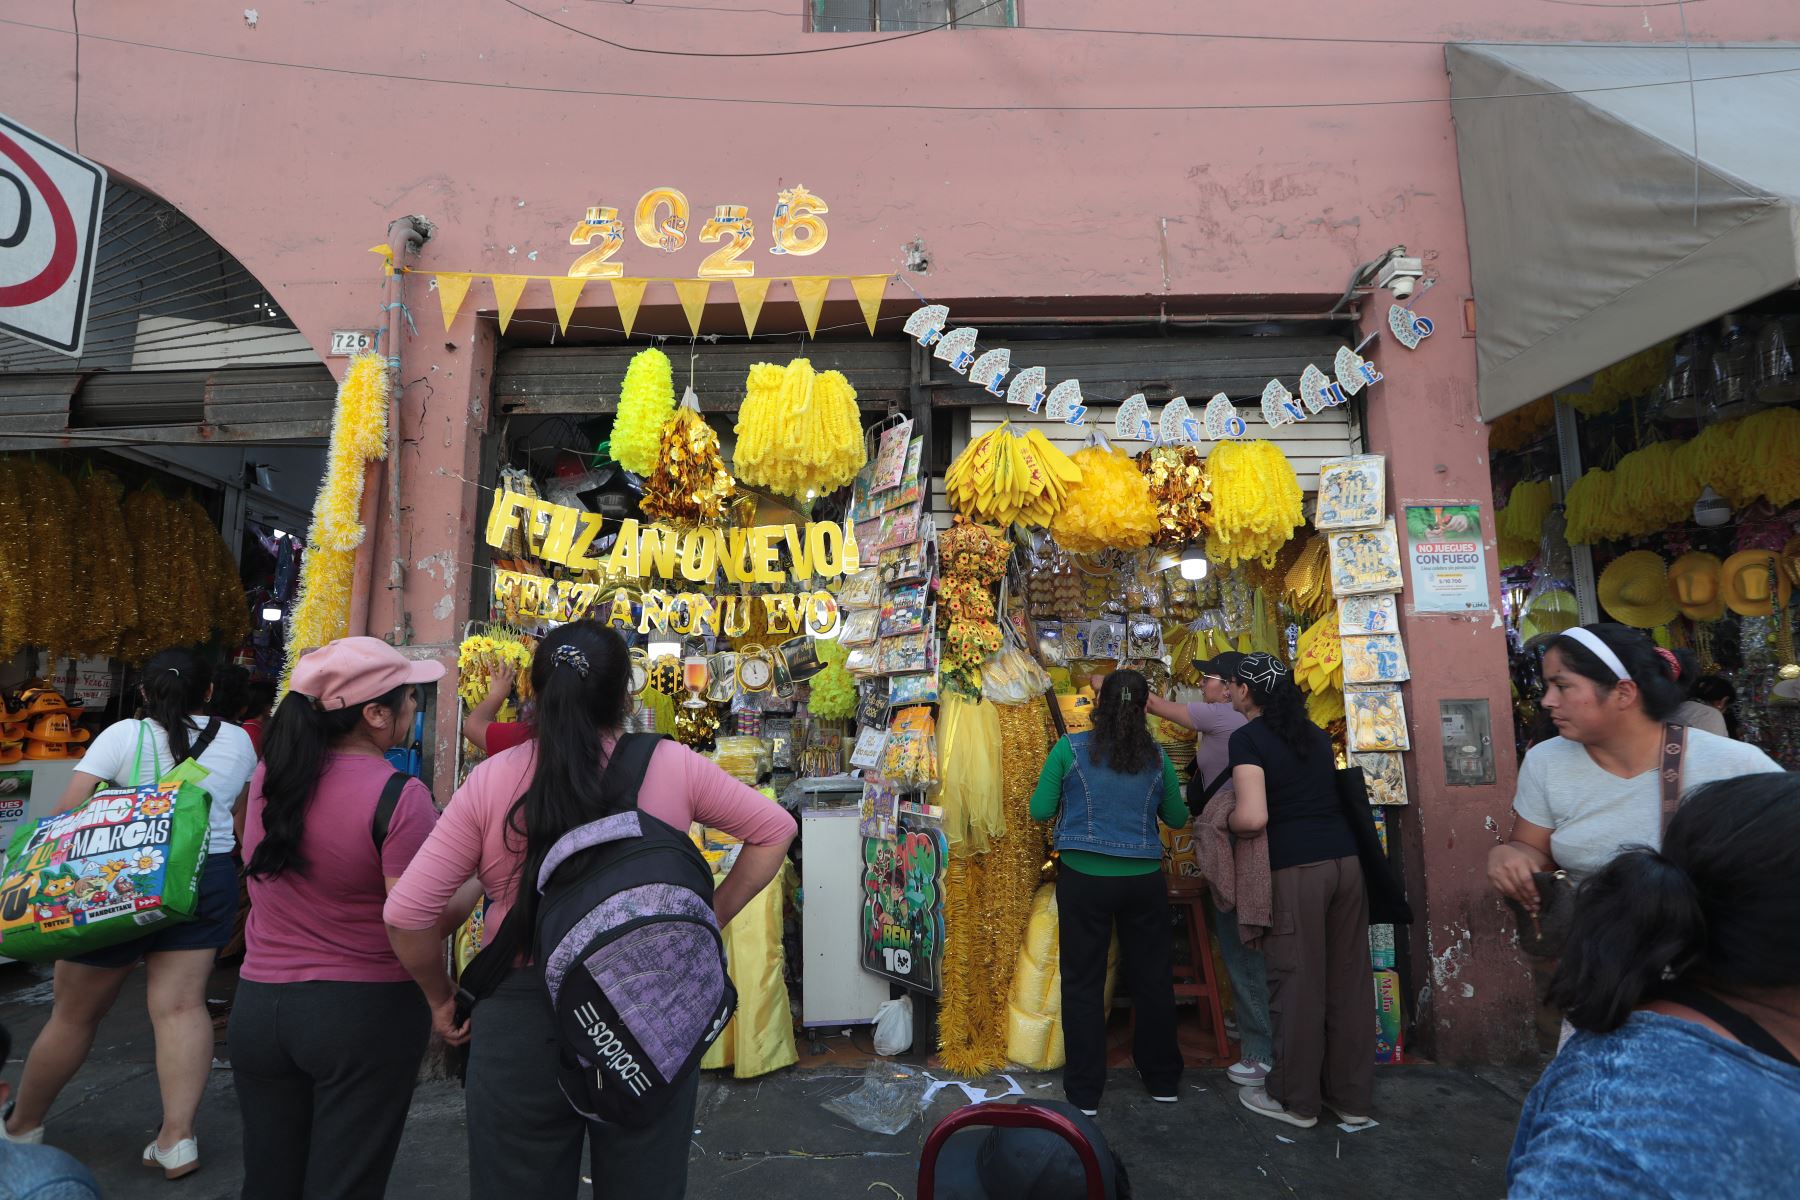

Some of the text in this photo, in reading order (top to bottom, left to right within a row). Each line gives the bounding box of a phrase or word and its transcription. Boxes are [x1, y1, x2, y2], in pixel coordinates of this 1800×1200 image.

[568, 188, 828, 277] 2026
[336, 335, 366, 347] 726
[1416, 554, 1479, 564] CON FUEGO
[1419, 543, 1474, 553] NO JUEGUES
[70, 819, 170, 859] MARCAS
[89, 902, 132, 918] WANDERTAKU
[883, 924, 910, 950] BEN
[883, 947, 911, 975] 10
[587, 1021, 641, 1080] adidas
